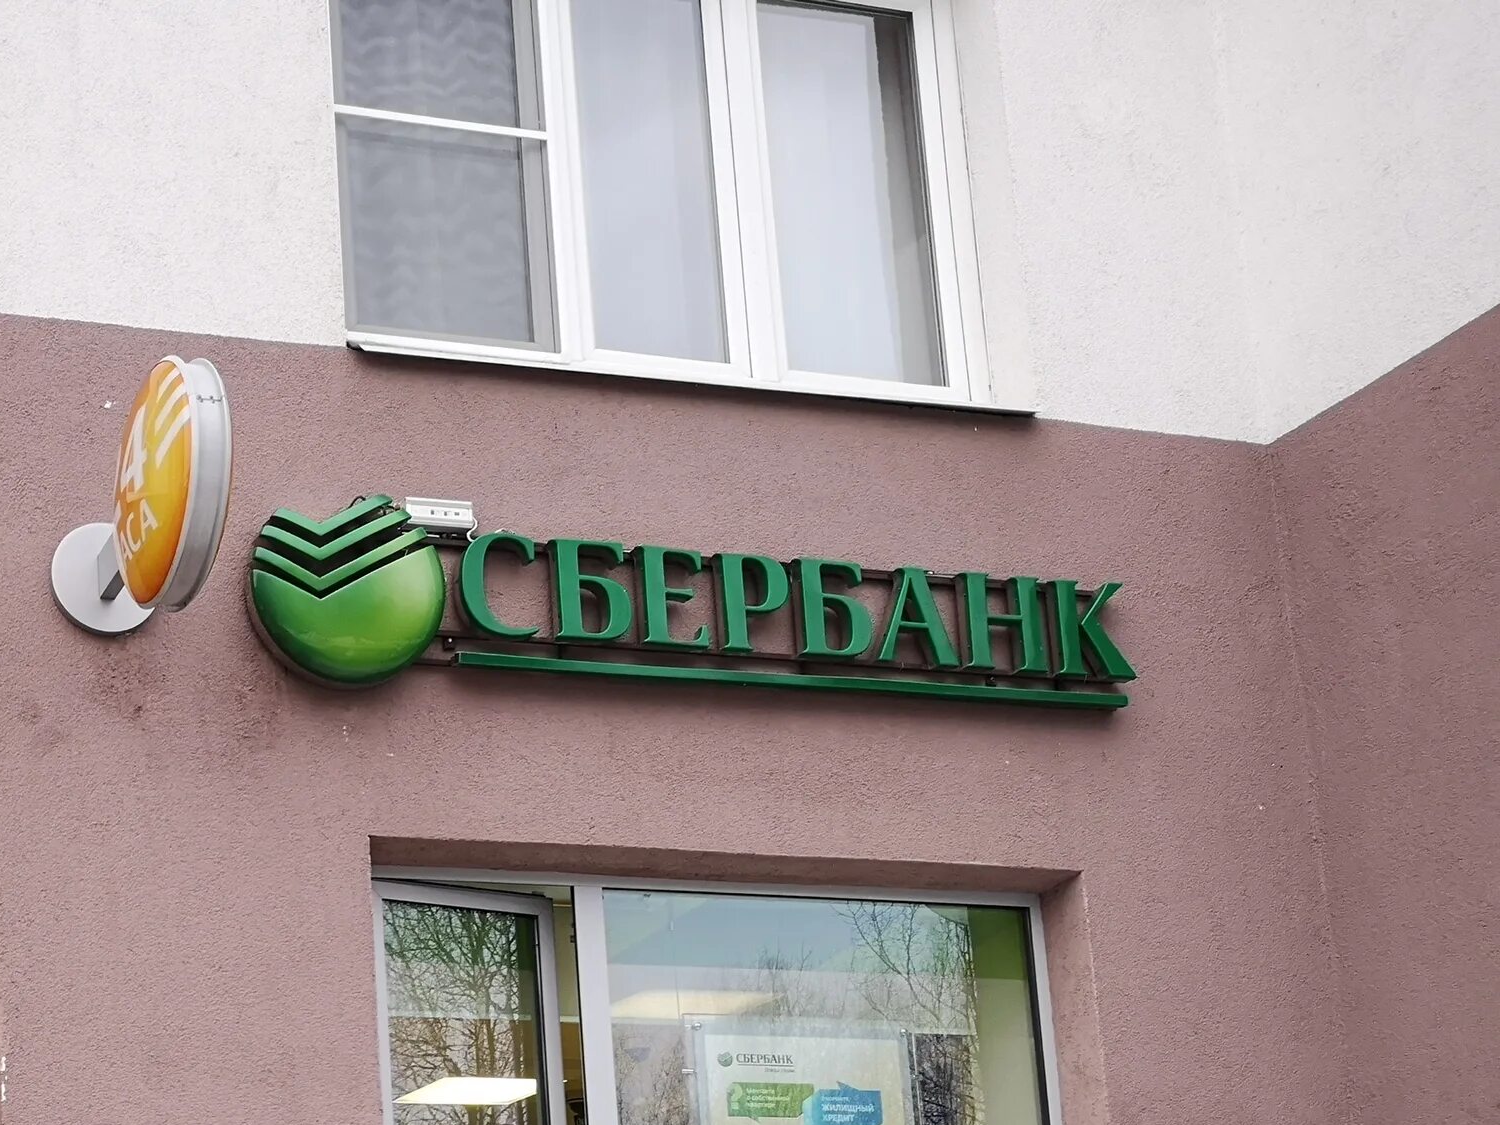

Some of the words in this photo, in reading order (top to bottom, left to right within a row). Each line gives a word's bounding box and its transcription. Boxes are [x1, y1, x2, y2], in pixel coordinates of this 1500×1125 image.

[118, 498, 159, 564] АСА
[458, 531, 1140, 684] СБЕРБАНК
[736, 1053, 794, 1065] СБЕРБАНК
[821, 1102, 874, 1113] ЖИЛИЩНЫЙ
[821, 1114, 855, 1123] КРЕДИТ
